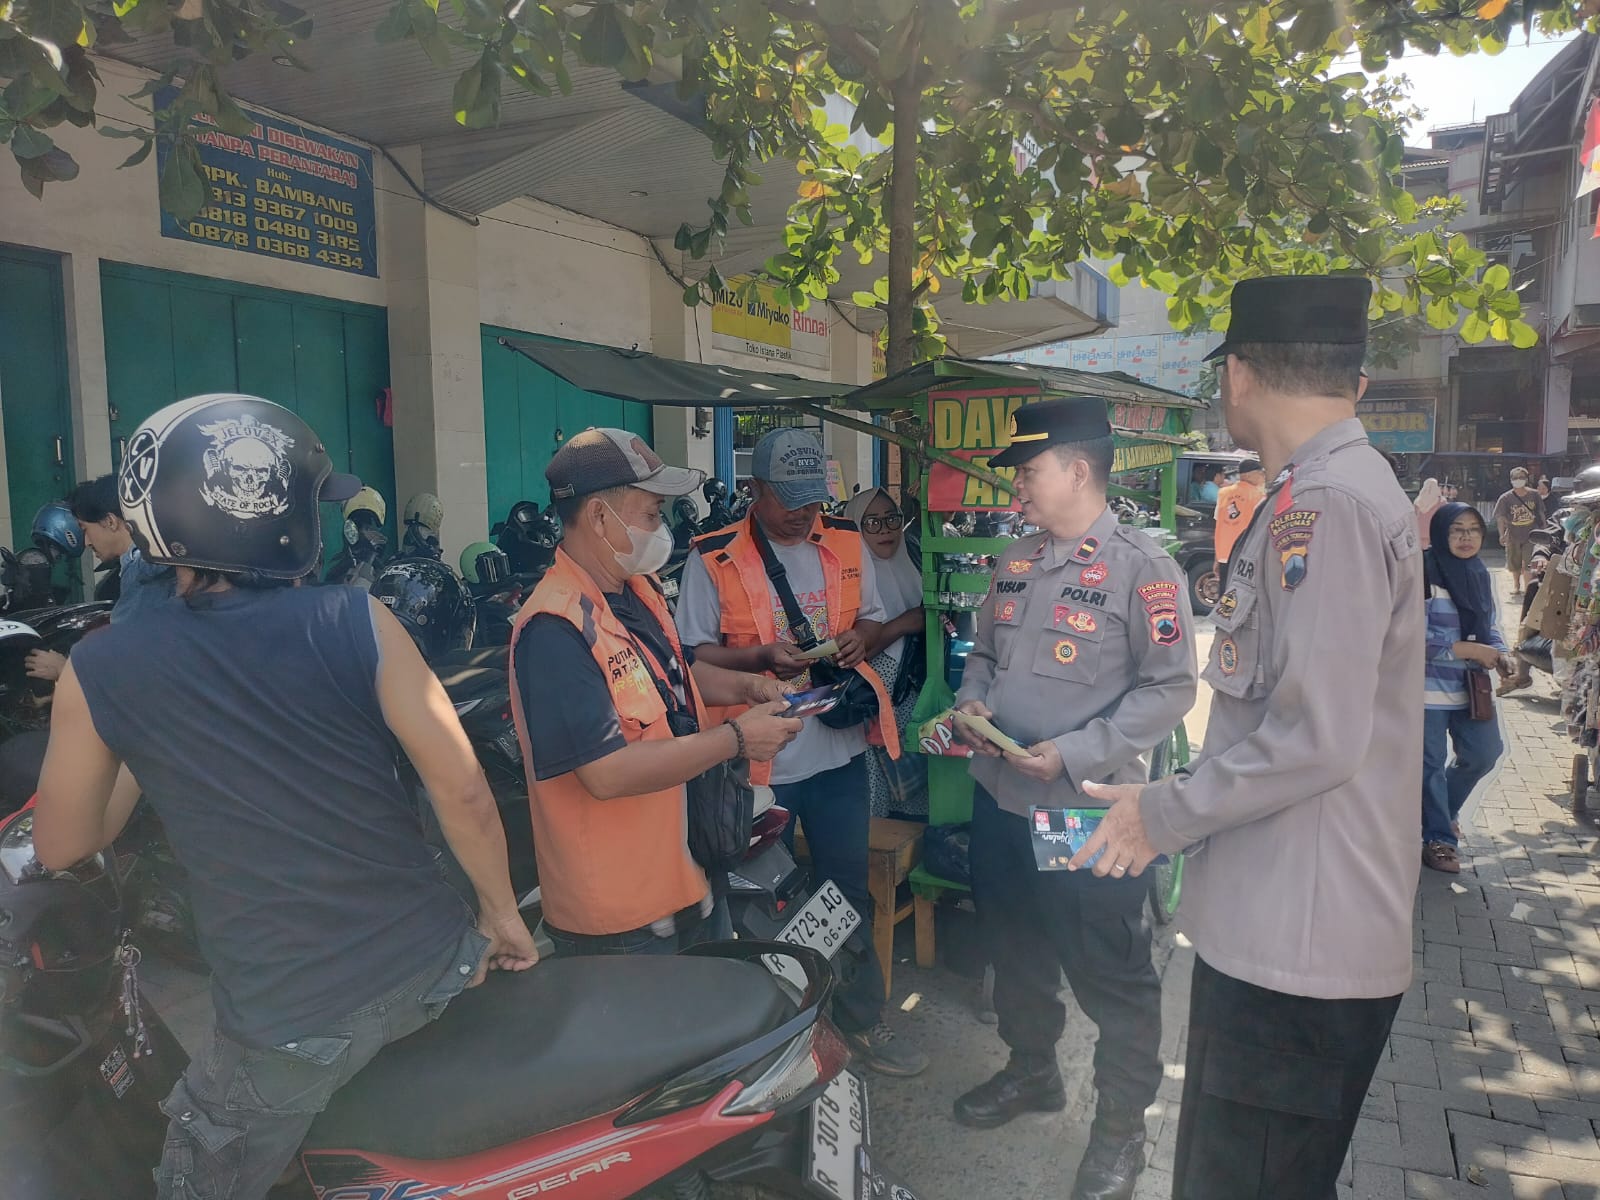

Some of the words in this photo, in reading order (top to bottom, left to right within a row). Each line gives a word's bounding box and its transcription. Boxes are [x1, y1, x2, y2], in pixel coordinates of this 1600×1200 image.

[268, 126, 359, 169] DISEWAKAN
[267, 167, 291, 182] Hub:
[256, 178, 354, 216] BAMBANG
[253, 197, 306, 221] 9367
[313, 211, 358, 234] 1009
[189, 221, 249, 247] 0878
[256, 235, 310, 259] 0368
[315, 250, 364, 270] 4334
[254, 216, 311, 241] 0480
[316, 230, 360, 252] 3185
[757, 301, 790, 326] Miyako
[793, 309, 828, 338] Rinnai
[745, 342, 758, 355] Toko
[759, 347, 774, 358] Istana
[775, 350, 792, 361] Plastik
[213, 491, 237, 508] STATE
[240, 501, 250, 509] OF
[253, 500, 276, 509] ROCK
[1270, 511, 1317, 530] POLRESTA
[997, 580, 1027, 594] YUSUP
[1061, 587, 1107, 606] POLRI
[1141, 583, 1176, 593] POLRESTA
[769, 953, 786, 972] R
[817, 1094, 840, 1156] 3078
[507, 1151, 633, 1200] GEAR
[817, 1169, 838, 1193] R
